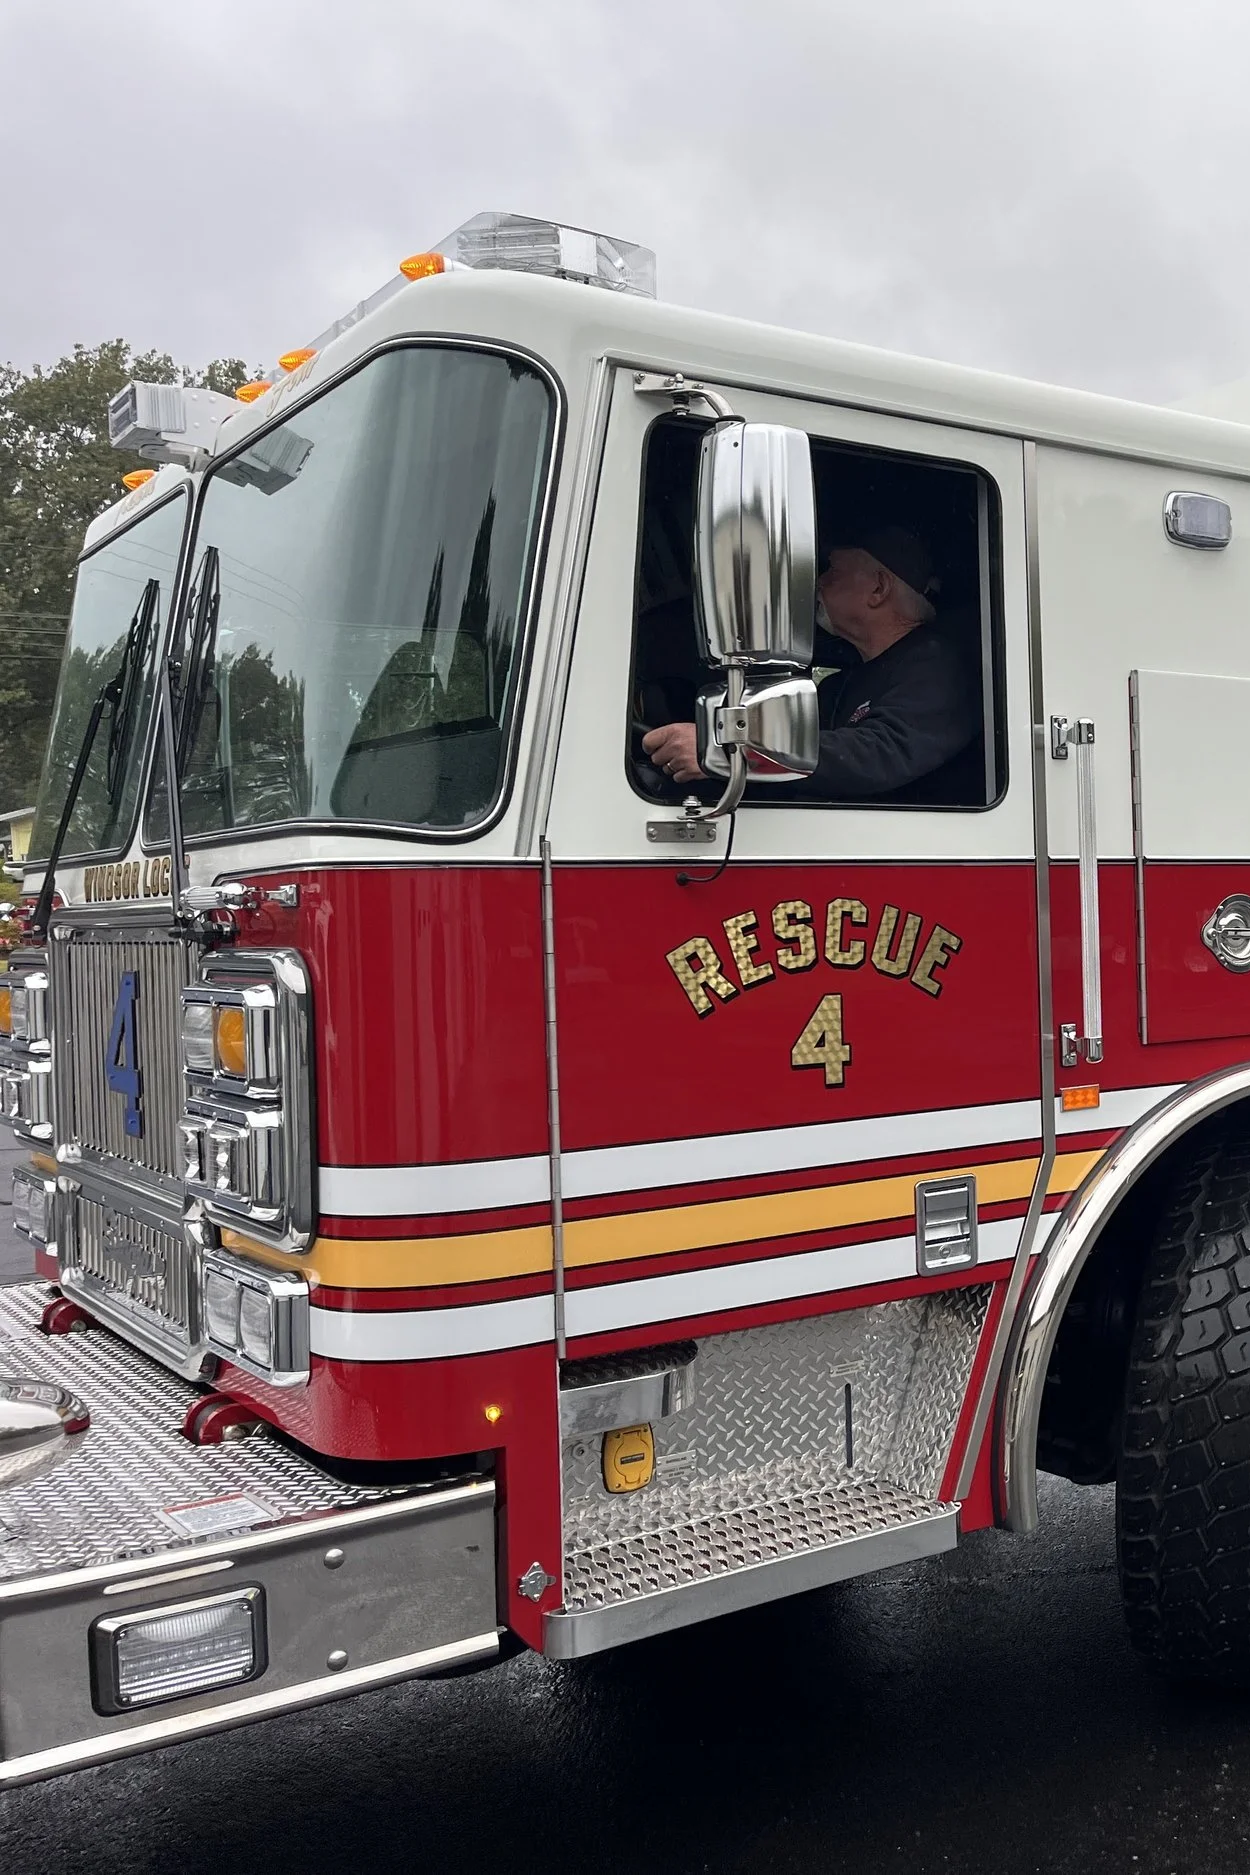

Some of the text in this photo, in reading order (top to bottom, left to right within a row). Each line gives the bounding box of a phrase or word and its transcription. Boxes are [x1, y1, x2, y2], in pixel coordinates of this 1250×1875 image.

[84, 854, 190, 902] WINDSOR LOC
[665, 897, 963, 1020] RESCUE
[106, 970, 146, 1140] 4
[791, 992, 852, 1089] 4
